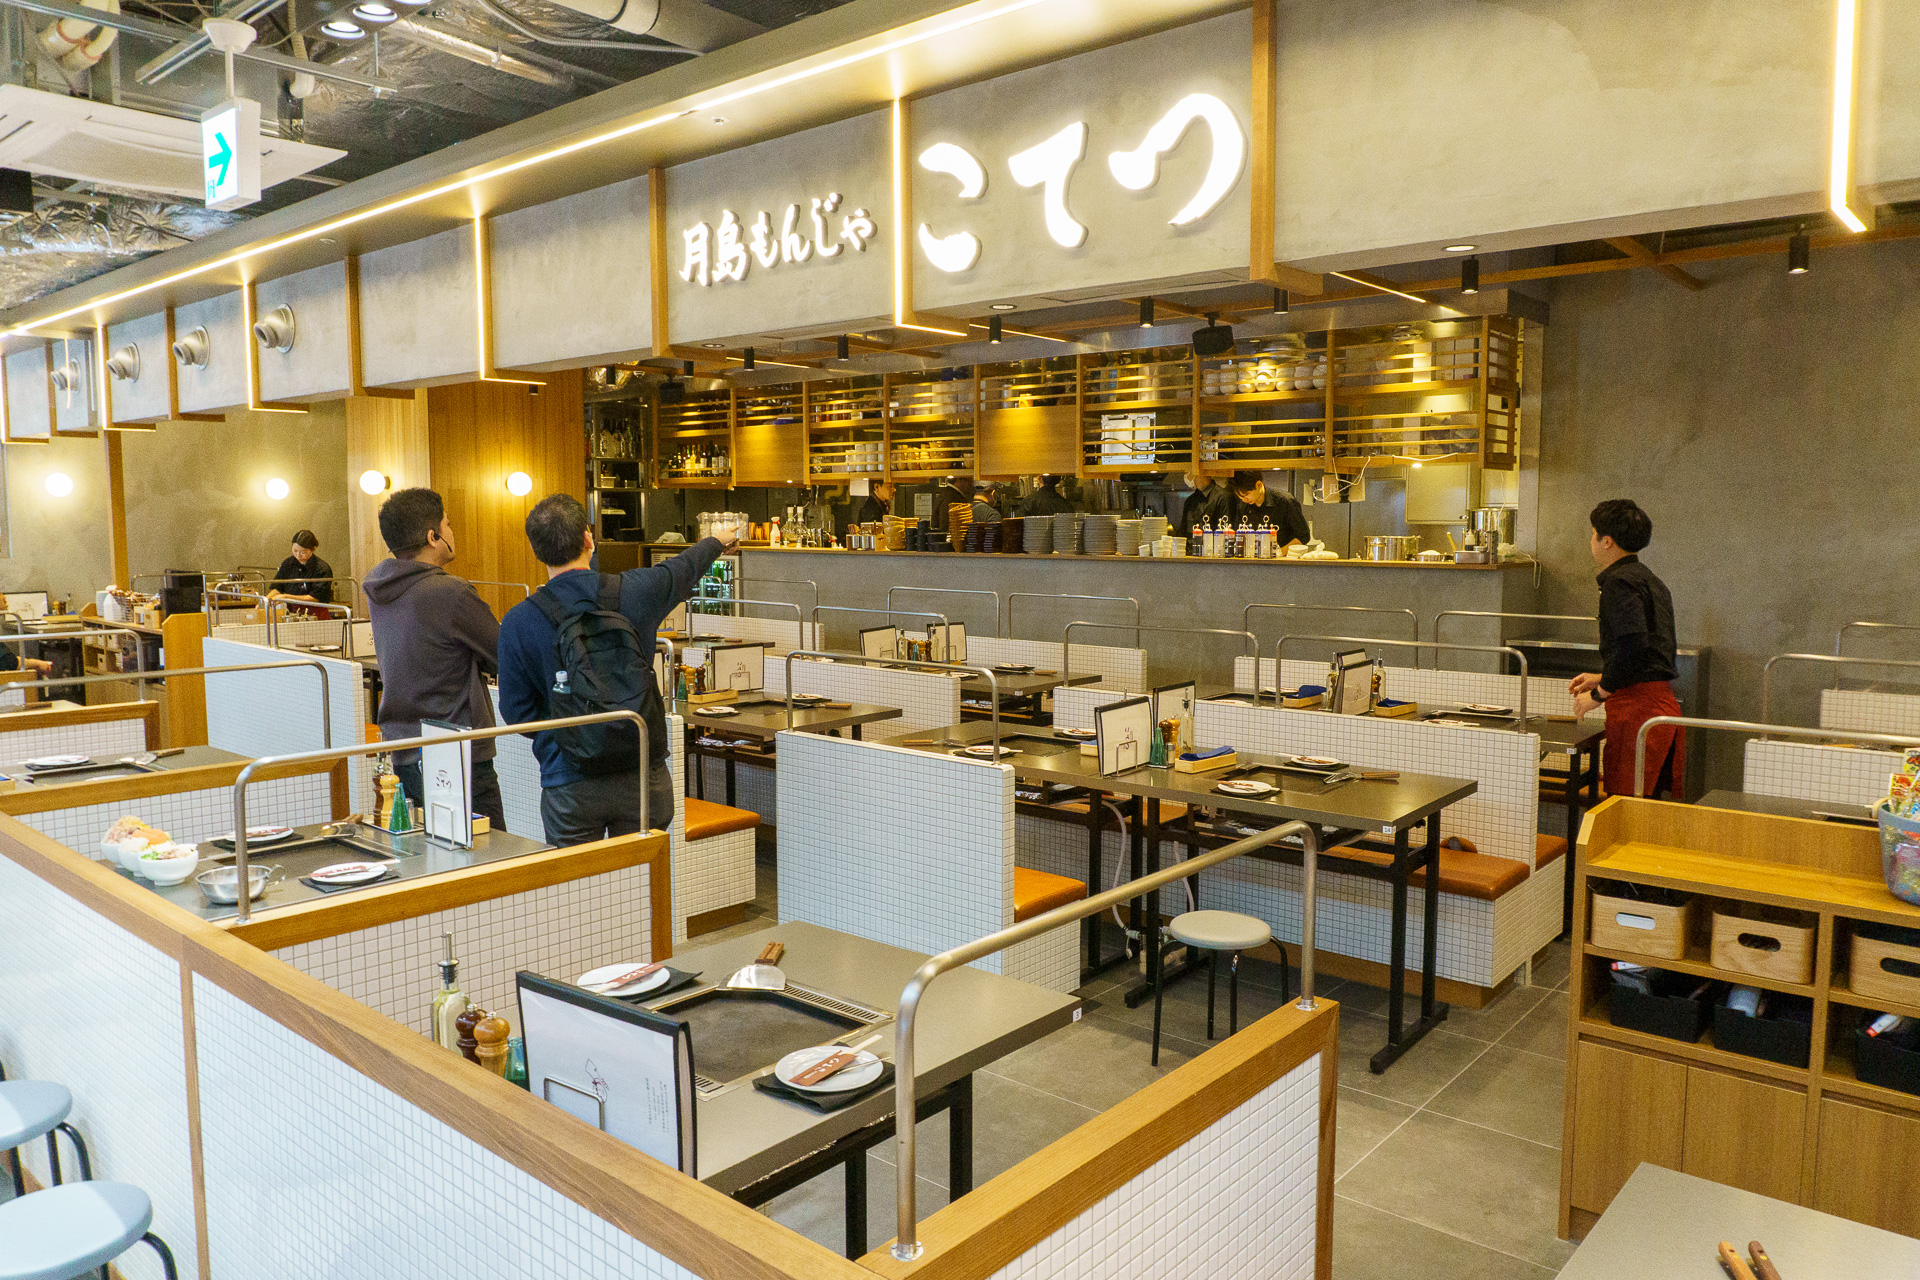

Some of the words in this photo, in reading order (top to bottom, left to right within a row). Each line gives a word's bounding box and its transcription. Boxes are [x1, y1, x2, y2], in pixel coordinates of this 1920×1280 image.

[679, 192, 875, 287] 月島もんじゃ
[918, 92, 1245, 272] こてつ
